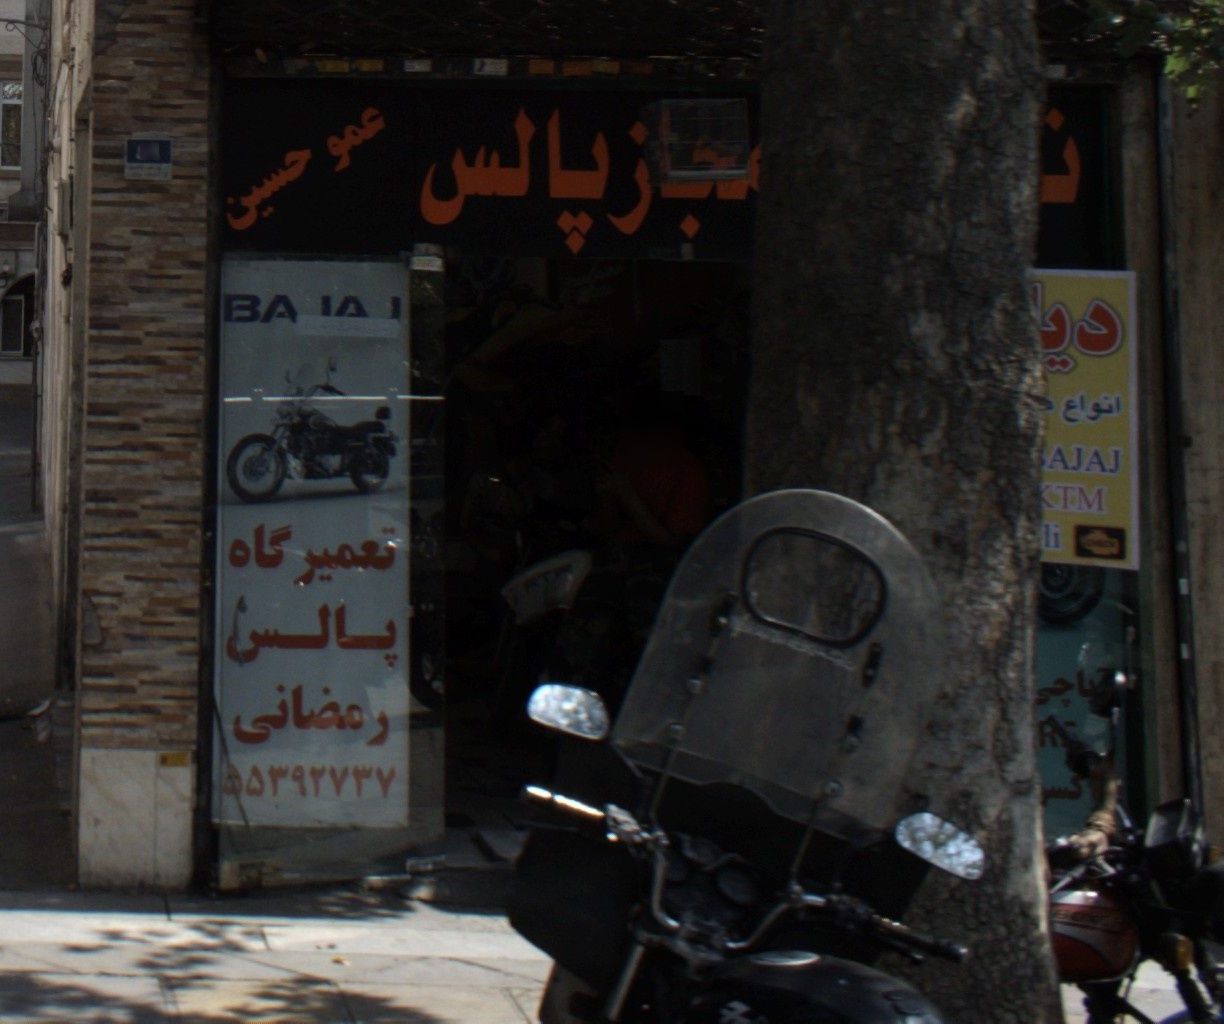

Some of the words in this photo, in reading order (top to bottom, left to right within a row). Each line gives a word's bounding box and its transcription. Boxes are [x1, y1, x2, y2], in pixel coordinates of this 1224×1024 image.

[326, 105, 387, 174] عمو
[225, 146, 313, 232] حسین
[418, 105, 610, 256] پالس
[1061, 393, 1122, 424] انواع
[1036, 484, 1105, 512] KTM
[226, 602, 399, 668] پالس
[232, 684, 390, 746] رمضانی
[222, 763, 398, 799] ۵۵۳۹۲۷۳۷
